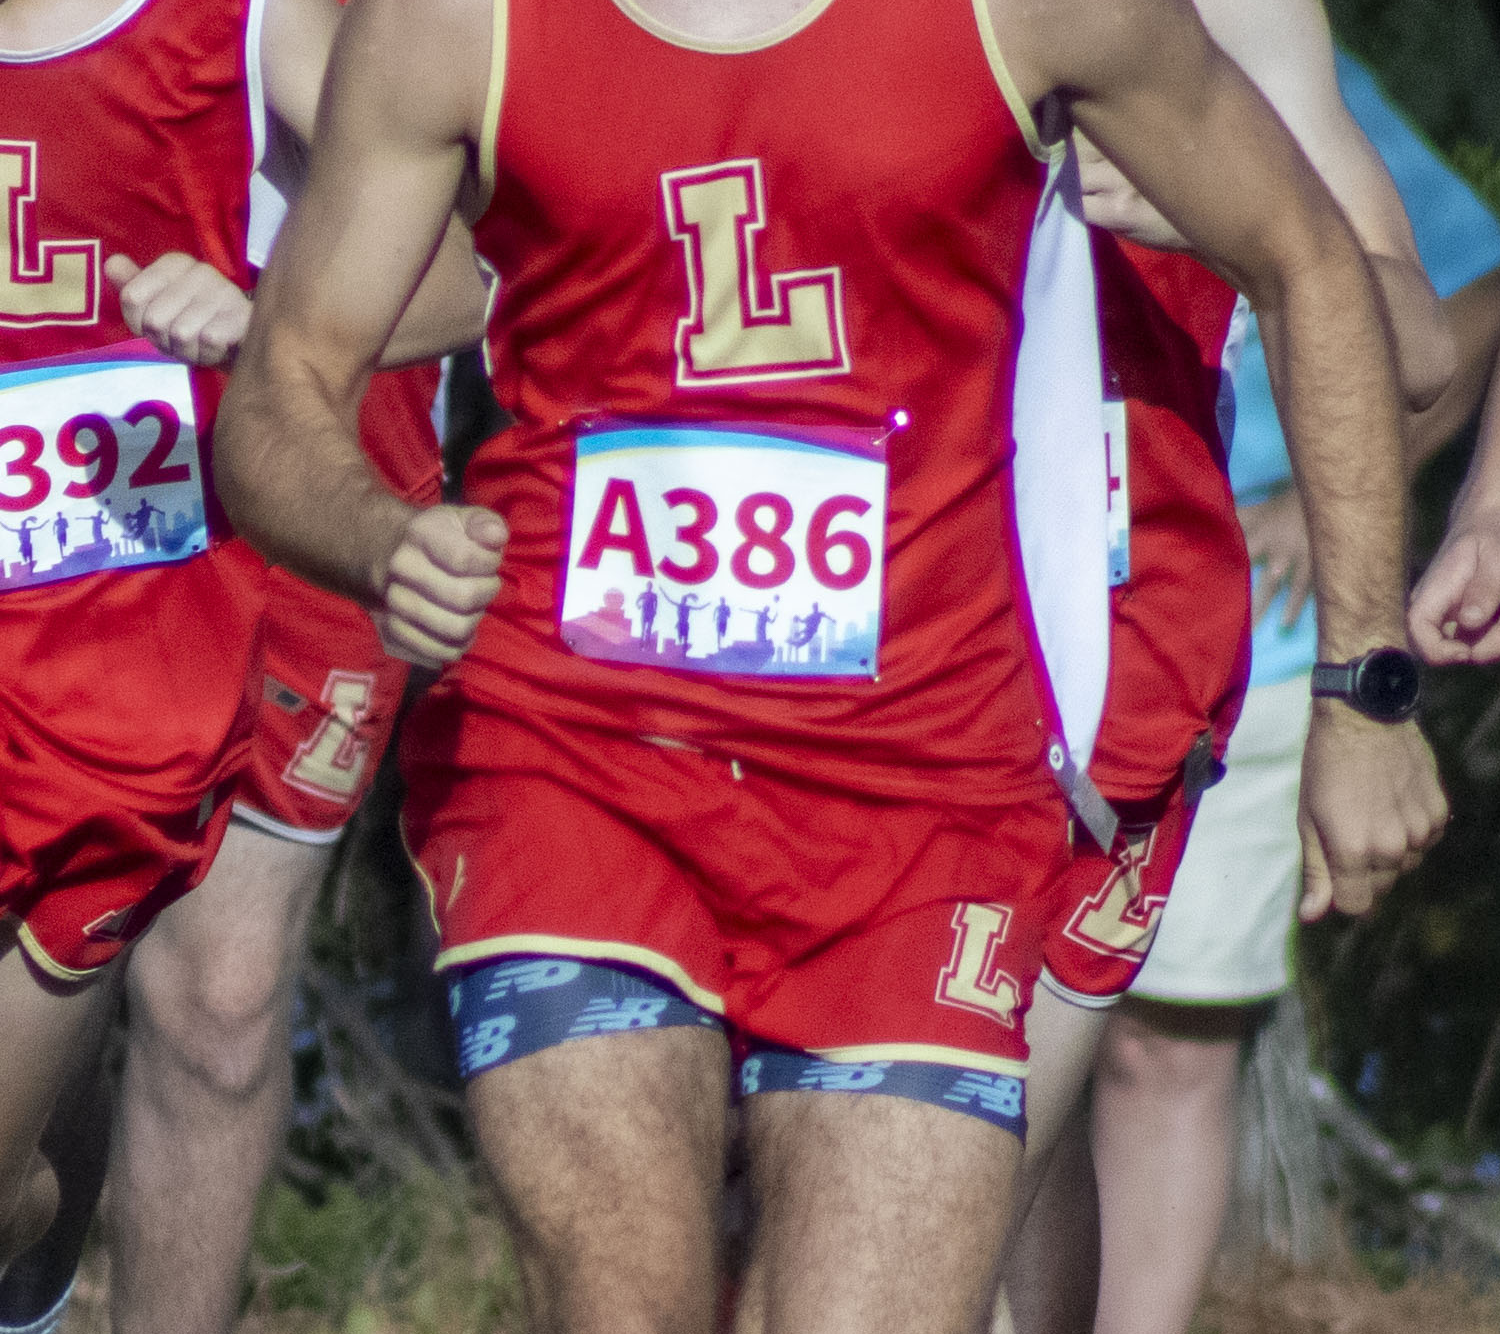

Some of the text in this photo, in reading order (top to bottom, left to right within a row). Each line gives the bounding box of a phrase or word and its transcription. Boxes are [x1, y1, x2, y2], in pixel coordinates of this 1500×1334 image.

[661, 158, 850, 387] L
[576, 479, 872, 592] A386
[934, 901, 1021, 1029] L
